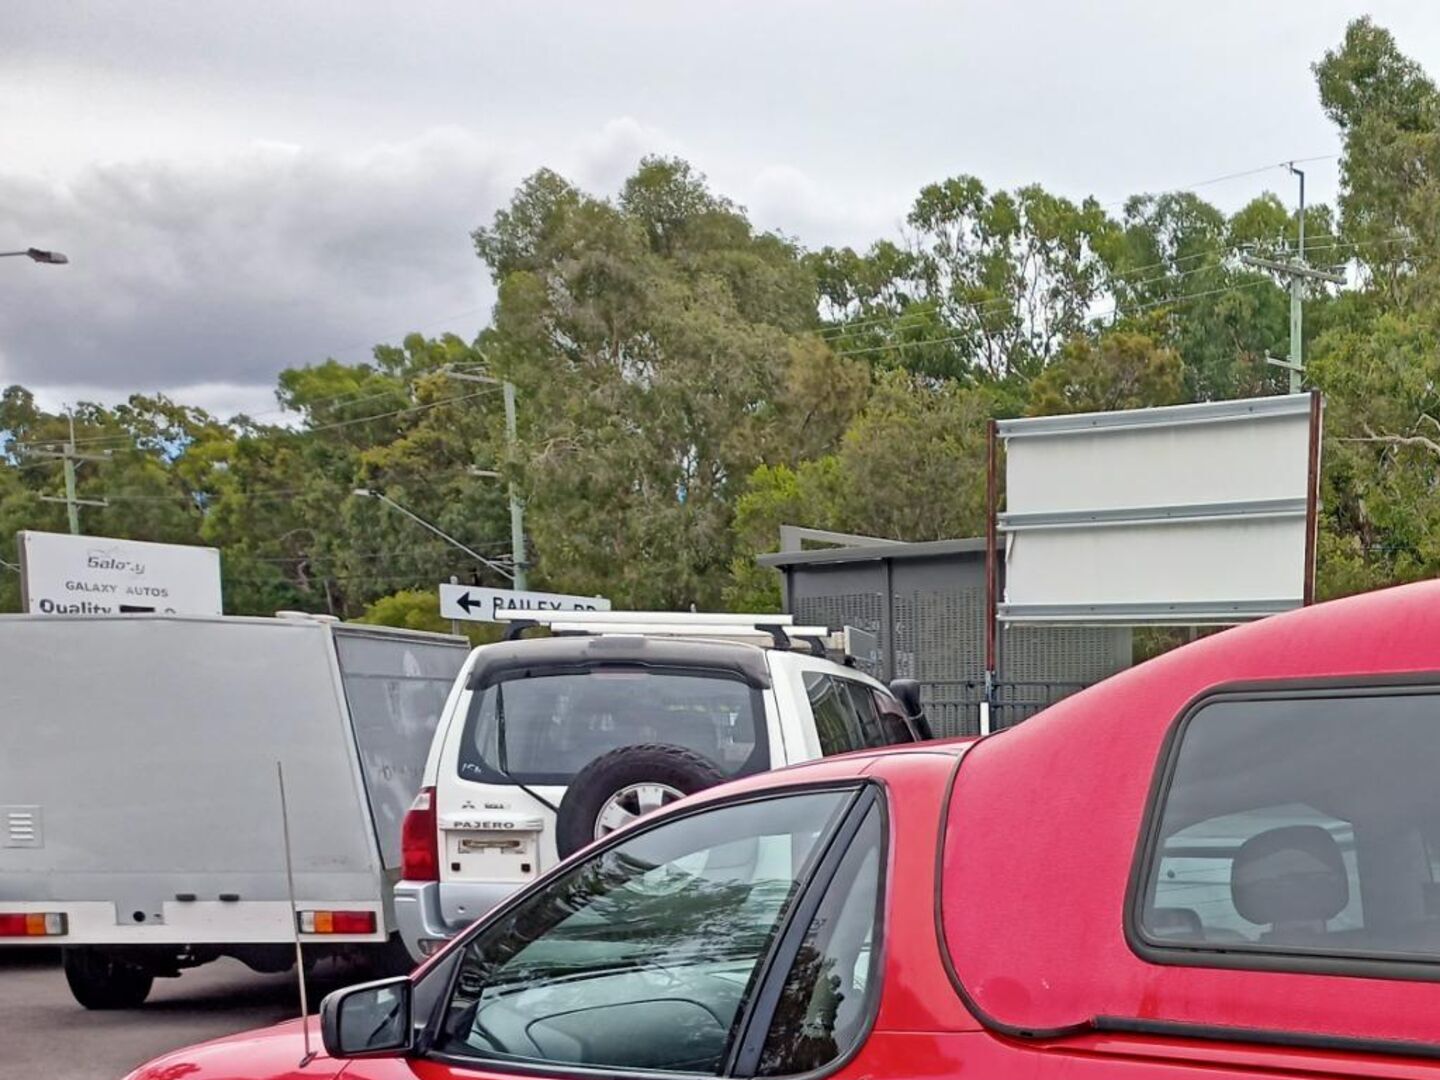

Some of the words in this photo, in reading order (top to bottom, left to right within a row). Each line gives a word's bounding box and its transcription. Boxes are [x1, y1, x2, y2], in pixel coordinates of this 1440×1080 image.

[65, 580, 118, 593] GALAXY
[126, 584, 169, 598] AUTOS
[453, 821, 515, 829] PAJERO
